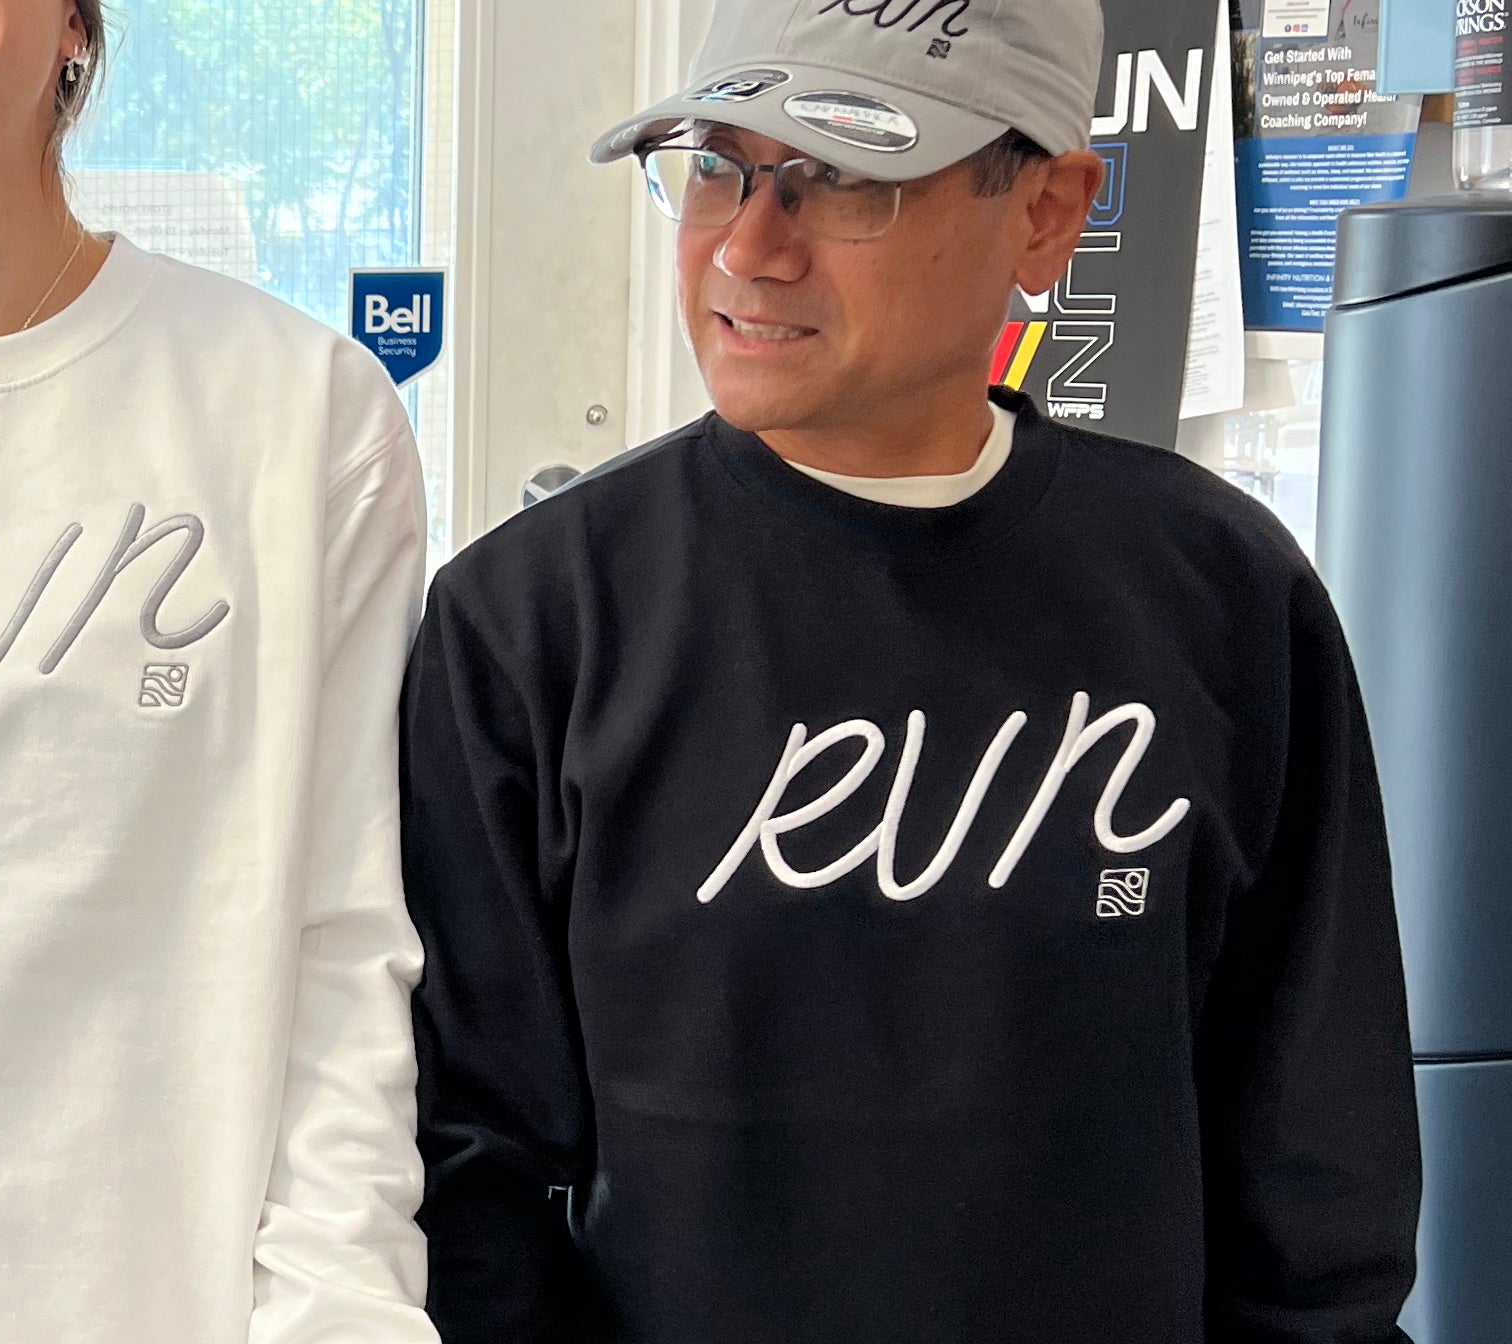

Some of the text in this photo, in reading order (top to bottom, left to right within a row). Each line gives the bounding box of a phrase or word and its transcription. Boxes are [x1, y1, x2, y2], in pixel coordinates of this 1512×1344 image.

[1264, 45, 1352, 65] Get Started With
[1263, 66, 1376, 87] Winnipeg's Top Fema
[1262, 93, 1300, 107] Owned
[1313, 89, 1361, 107] Operated
[1261, 111, 1368, 130] Coaching Company!
[365, 294, 430, 333] Bell
[378, 336, 417, 346] Business
[378, 346, 417, 357] Security
